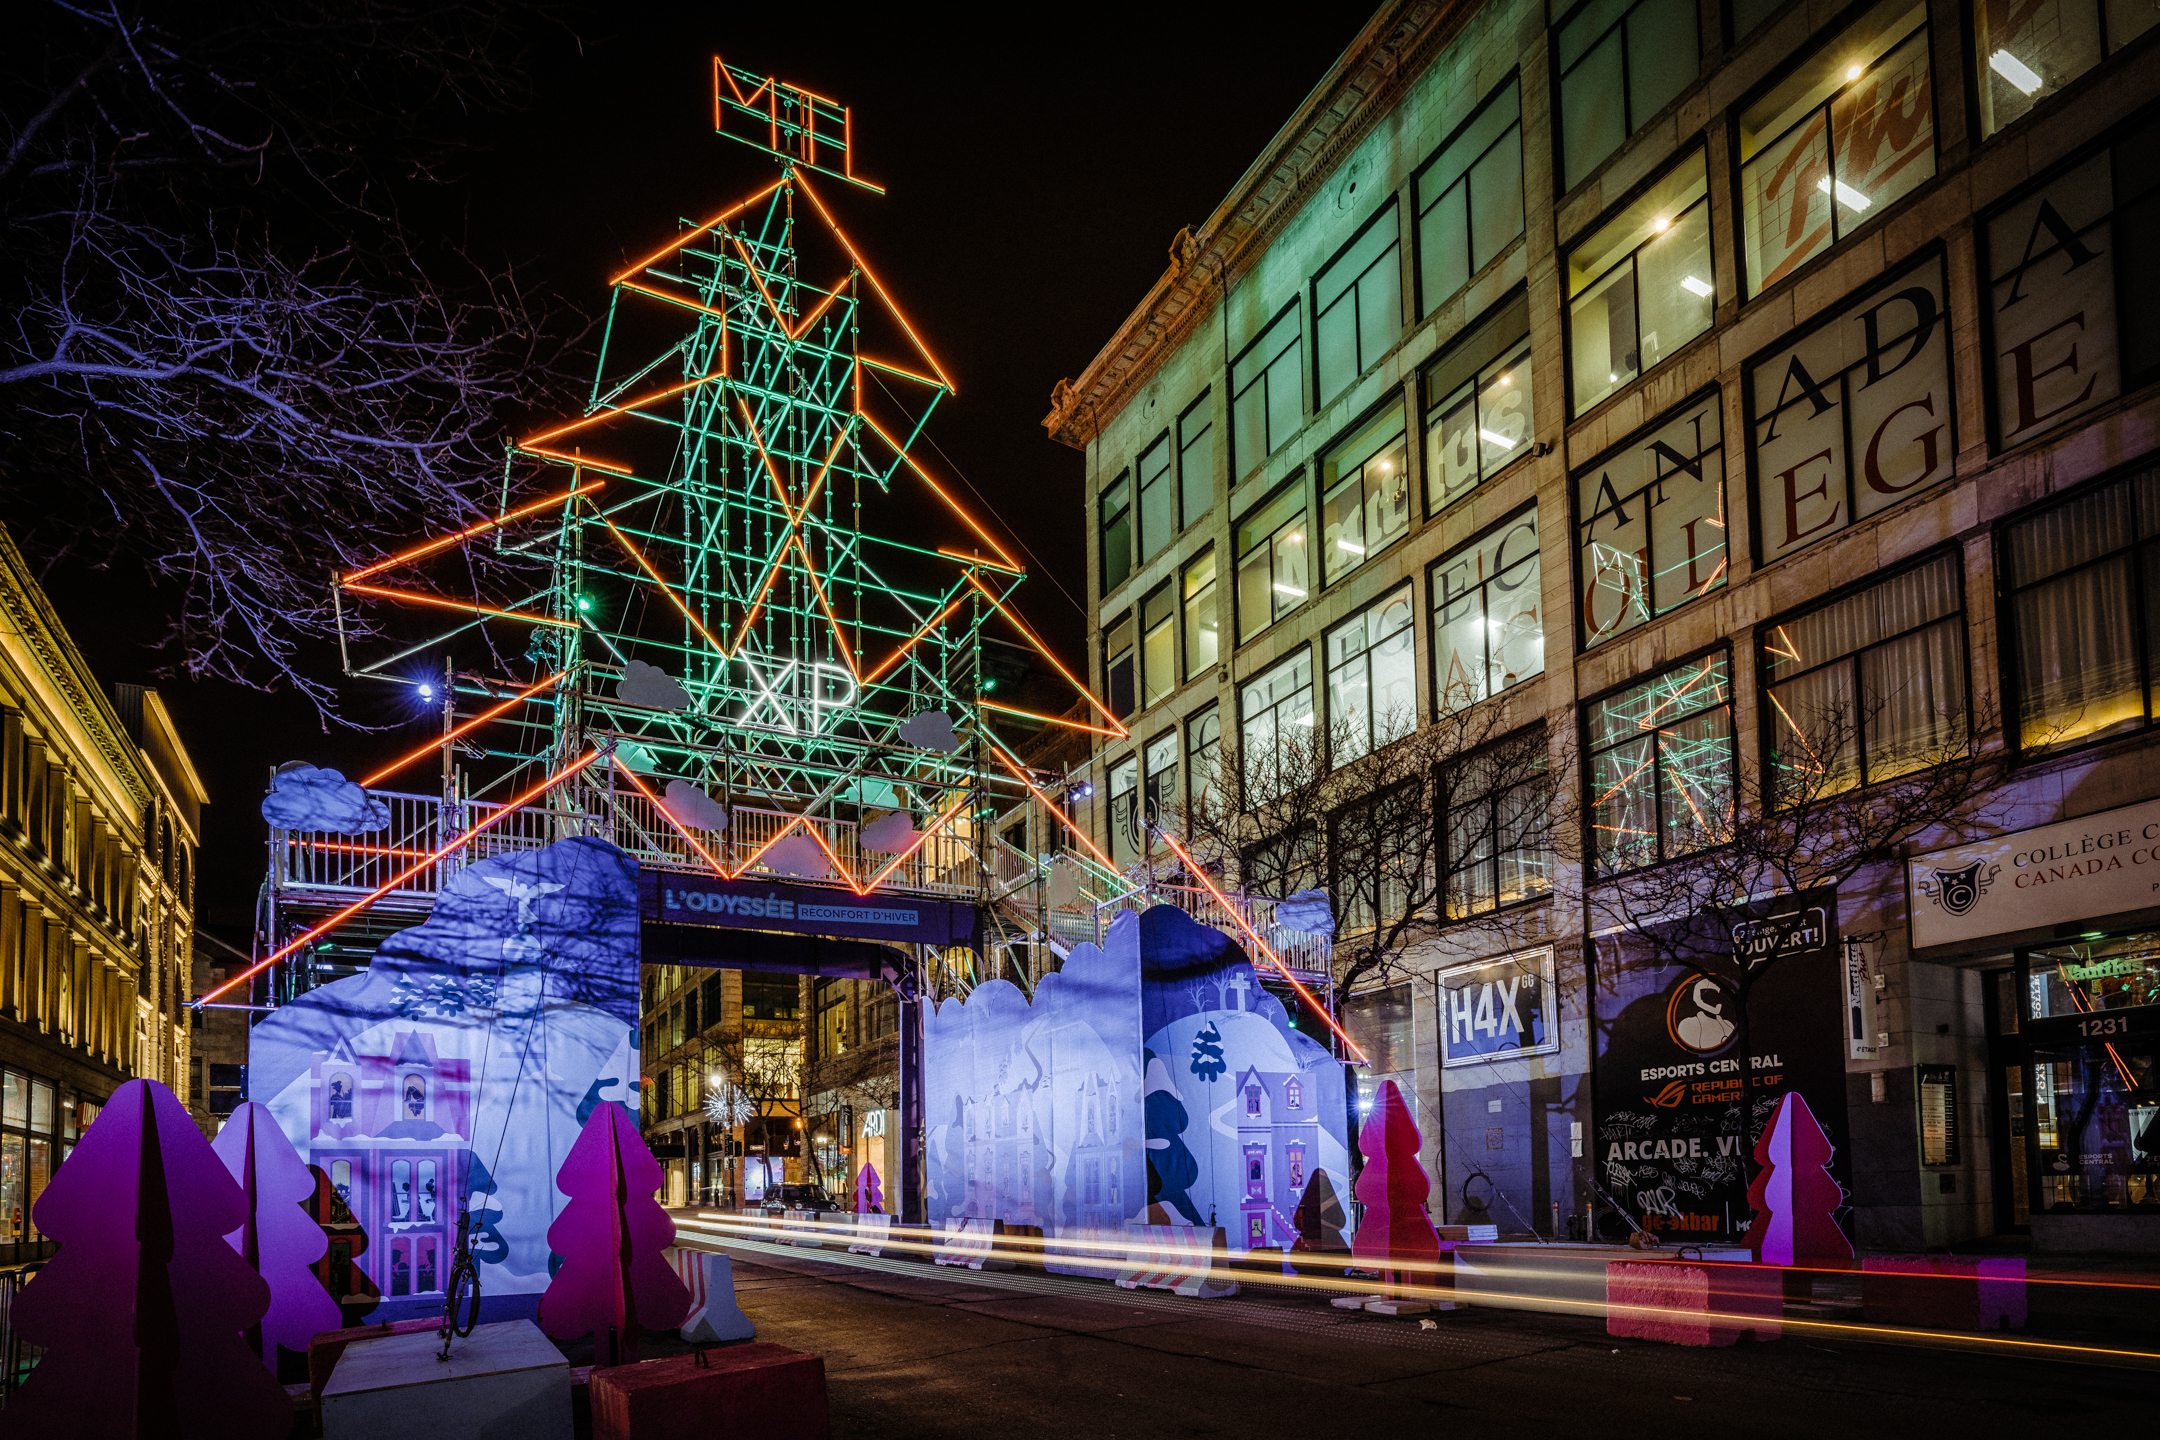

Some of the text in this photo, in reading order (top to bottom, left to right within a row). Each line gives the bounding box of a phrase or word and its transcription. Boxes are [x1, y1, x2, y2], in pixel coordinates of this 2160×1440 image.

[1275, 390, 1526, 614] Nautlus
[735, 647, 857, 738] XP
[2013, 829, 2132, 868] COLLÈGE
[2014, 855, 2124, 889] CANADA
[665, 888, 795, 920] L'ODYSSÉE
[873, 911, 916, 923] D'HIVER
[1450, 976, 1525, 1044] H4X
[2078, 1017, 2128, 1037] 1231
[1641, 1054, 1783, 1081] ESPORTS CENRAL
[1764, 1074, 1784, 1086] OF
[1692, 1091, 1742, 1105] GAMER
[1607, 1137, 1709, 1162] ARCADE.
